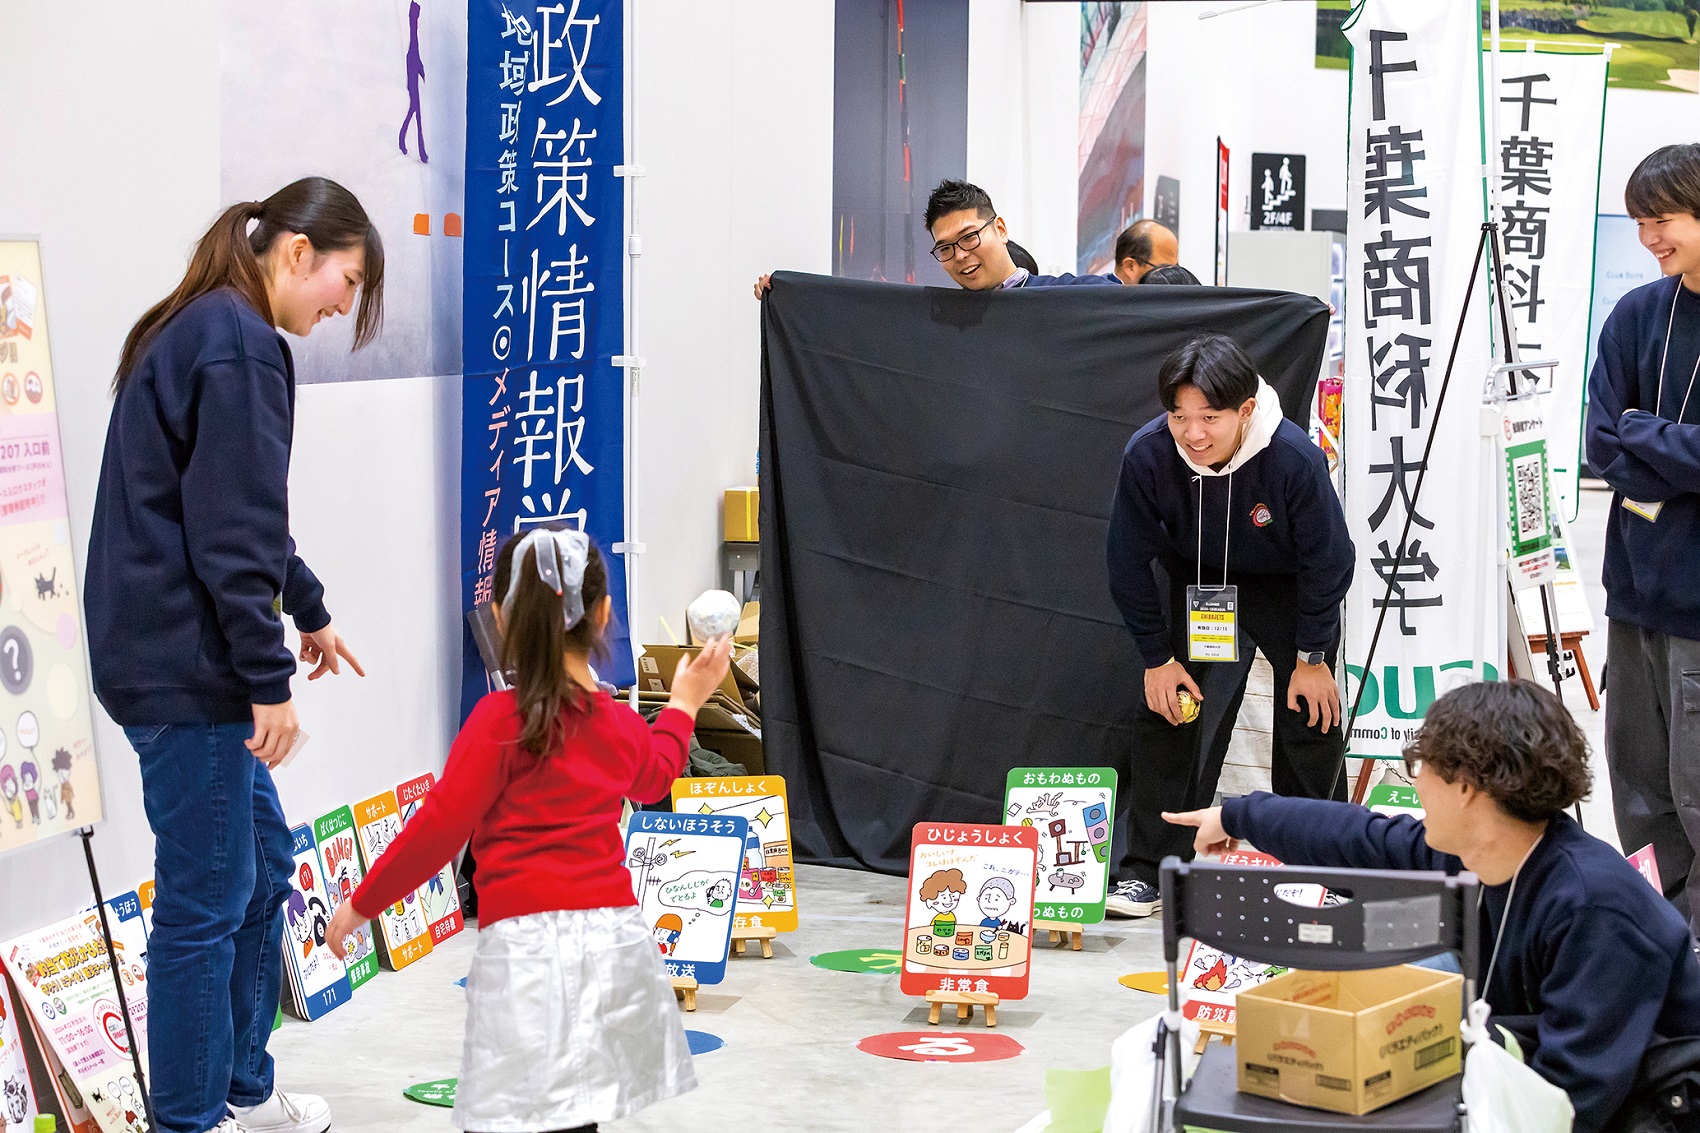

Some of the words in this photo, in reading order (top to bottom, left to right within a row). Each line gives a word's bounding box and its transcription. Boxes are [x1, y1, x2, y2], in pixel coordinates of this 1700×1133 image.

[1263, 212, 1293, 225] 2F/4F
[1023, 772, 1101, 784] おもわぬもの
[690, 780, 767, 795] ほぞんしょく
[365, 800, 387, 818] サポート
[319, 812, 348, 837] ばくはつじこ
[641, 816, 736, 834] しないほうそう
[293, 833, 309, 851] いち
[927, 828, 1024, 845] ひじょうしょく
[325, 836, 353, 878] BANG!
[300, 869, 312, 887] 171
[402, 942, 423, 961] サポート
[940, 978, 990, 993] 非常食
[322, 988, 336, 1006] 171
